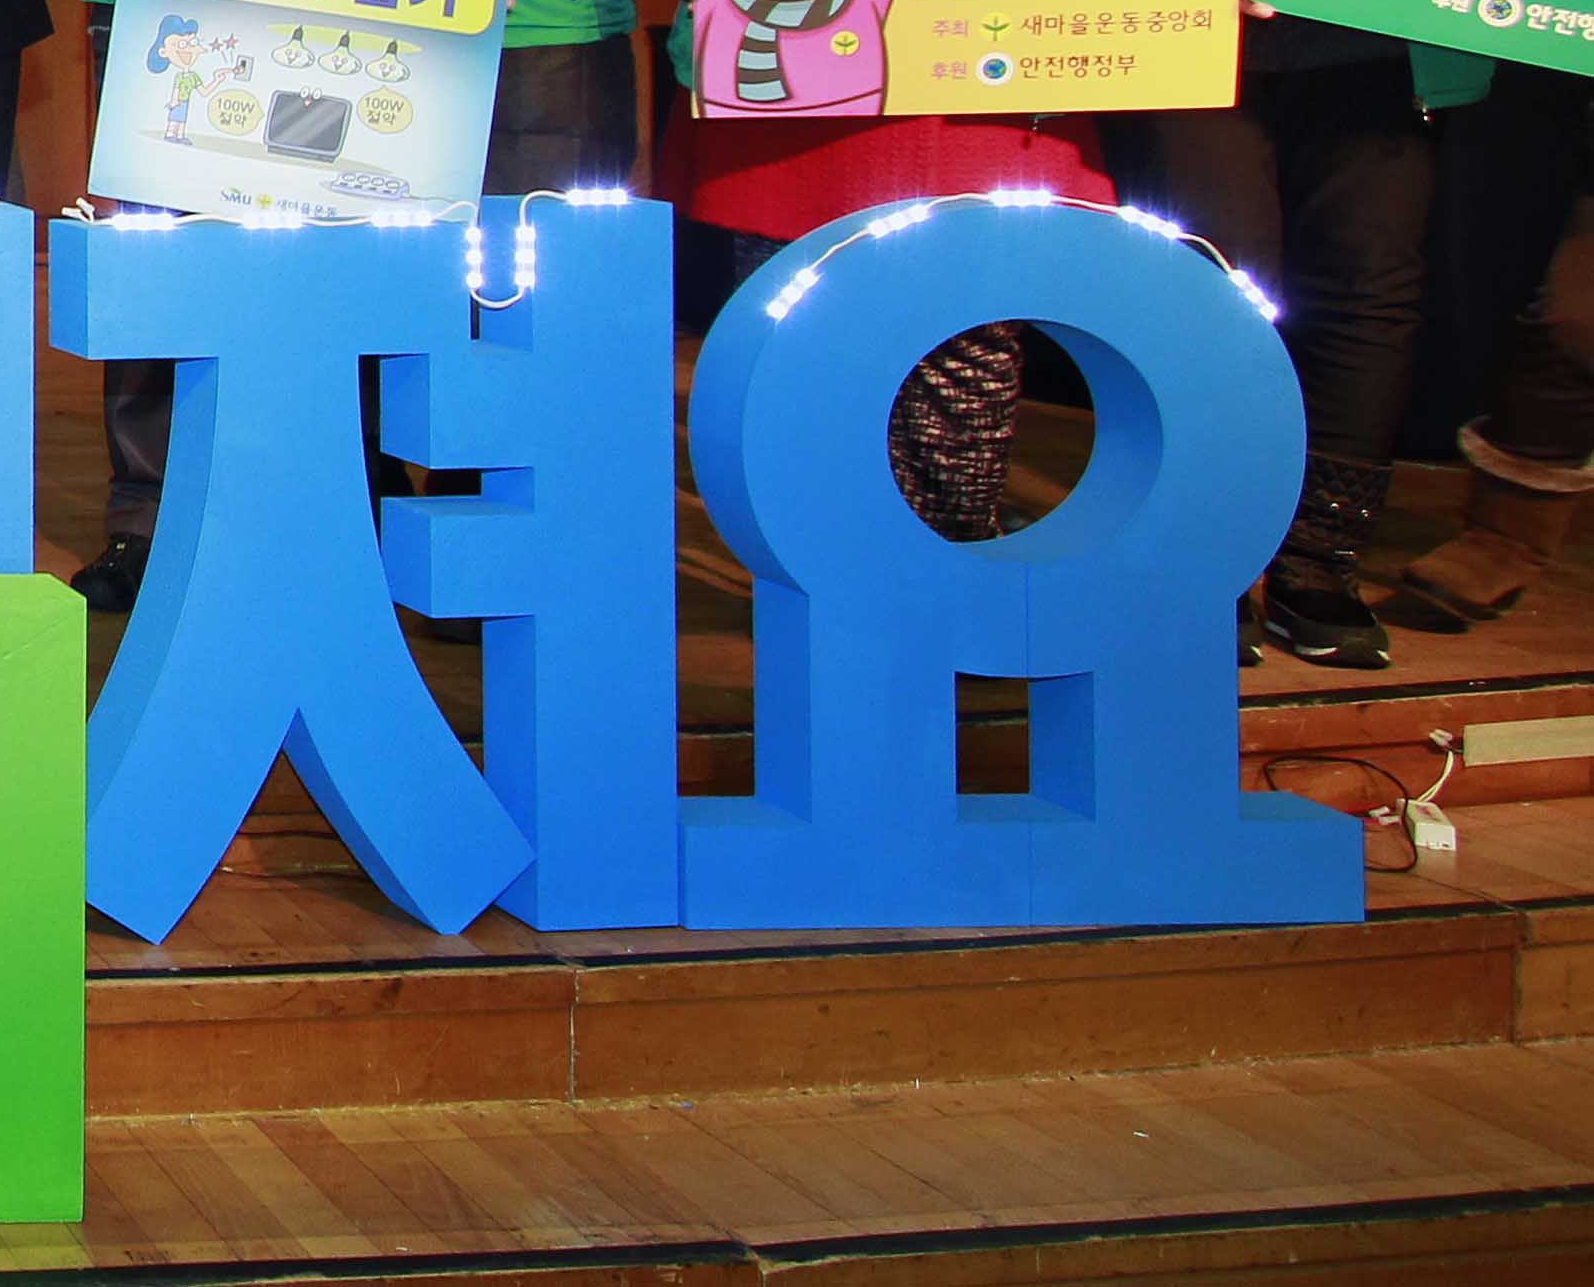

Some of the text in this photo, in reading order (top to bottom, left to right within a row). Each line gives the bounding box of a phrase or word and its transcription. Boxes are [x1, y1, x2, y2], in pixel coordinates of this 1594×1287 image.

[931, 8, 1214, 39] 주최 새마을운동중앙회
[930, 54, 1138, 81] 후원 안전행정부
[217, 96, 255, 114] 100W
[365, 95, 405, 113] 100W
